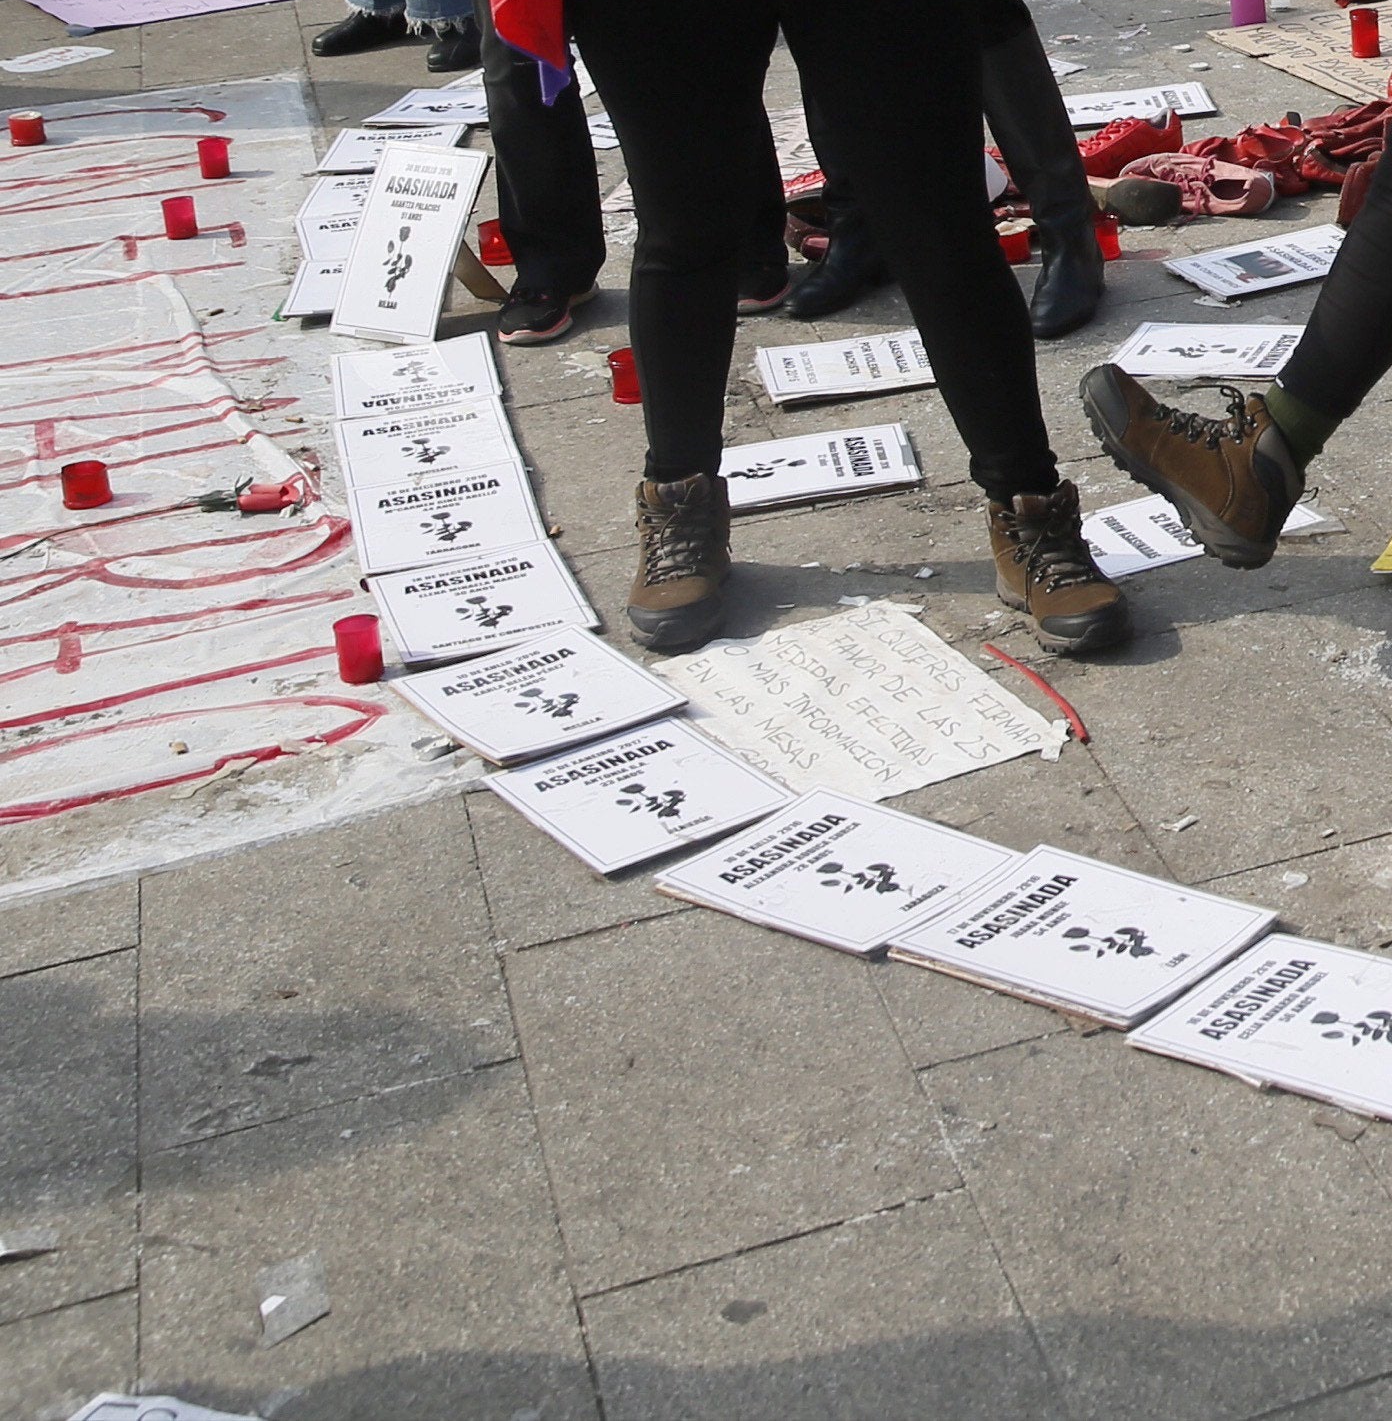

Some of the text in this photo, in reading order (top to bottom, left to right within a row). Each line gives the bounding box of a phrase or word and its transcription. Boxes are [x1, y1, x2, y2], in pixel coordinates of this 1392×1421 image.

[385, 176, 459, 200] ASASINADA
[378, 479, 501, 509] ASASINADA
[405, 561, 534, 594] ASASINADA
[440, 647, 578, 697] ASASINADA
[764, 633, 851, 699] MEDIDAS
[846, 695, 939, 768] EFECTIVAS
[826, 633, 889, 682] FAVOR
[884, 676, 922, 704] DE
[916, 705, 961, 740] LAS
[952, 735, 1003, 762] 25
[877, 628, 967, 693] QUIERES
[967, 687, 1043, 747] FIRMAR
[685, 658, 719, 684] EN
[713, 685, 755, 716] LAS
[753, 714, 824, 772] MESAS
[783, 690, 901, 783] INFORMACIÓN
[533, 739, 676, 793] ASASINADA
[718, 813, 849, 885] ASASINADA
[954, 873, 1081, 950] ASASINADA
[1198, 958, 1318, 1042] ASASINADA
